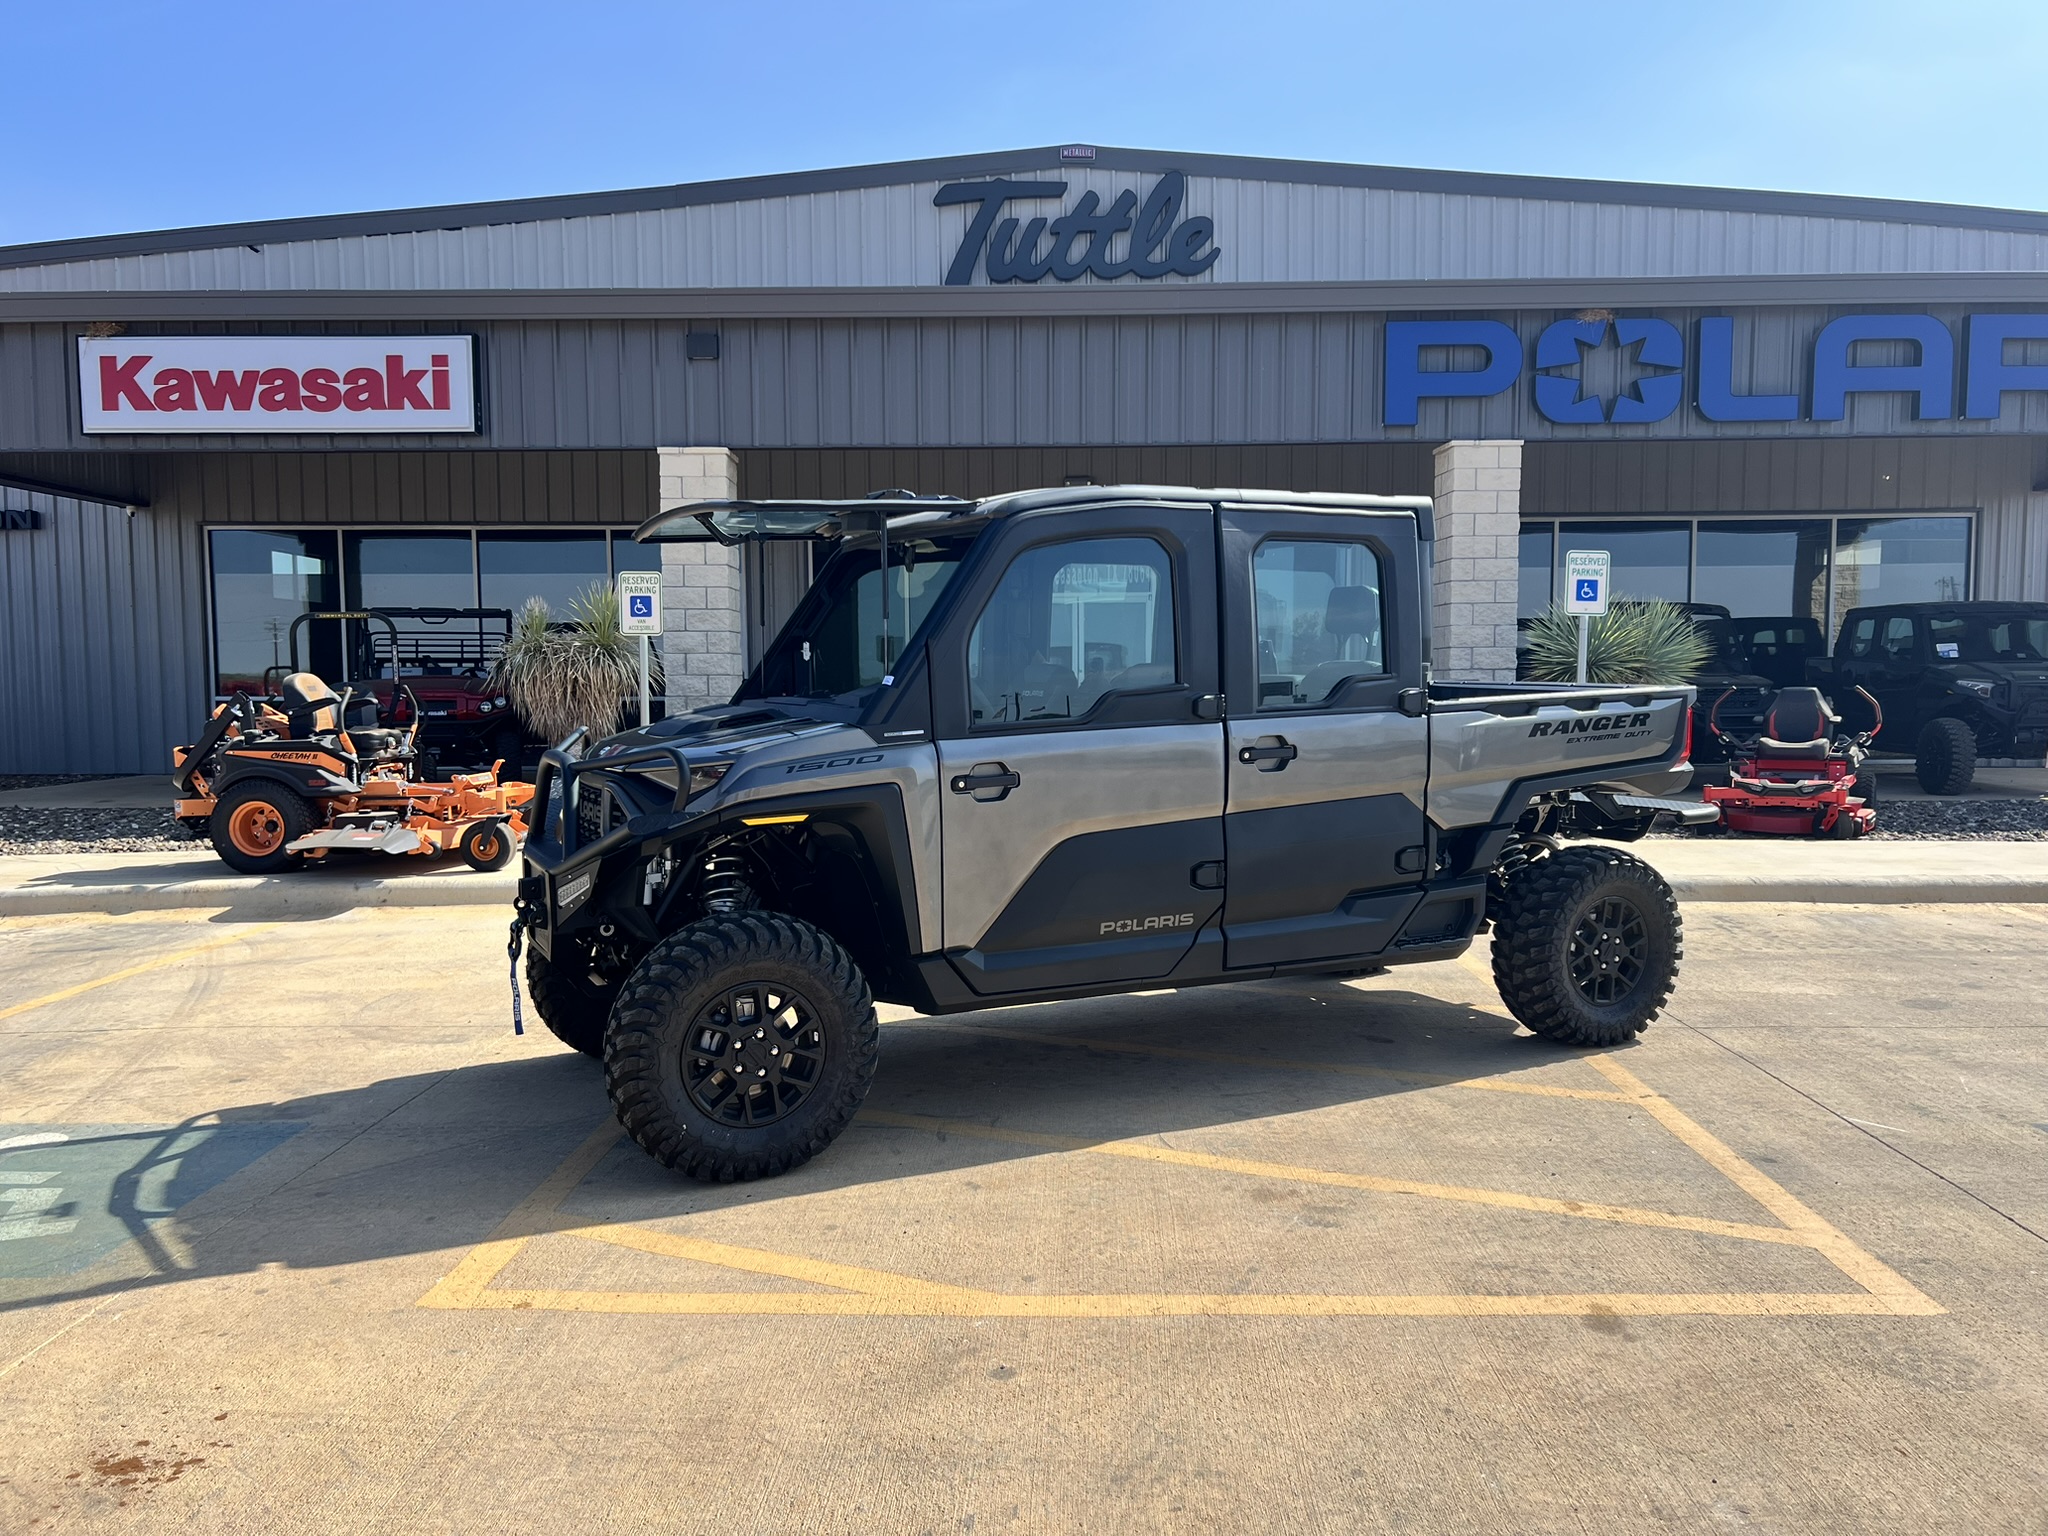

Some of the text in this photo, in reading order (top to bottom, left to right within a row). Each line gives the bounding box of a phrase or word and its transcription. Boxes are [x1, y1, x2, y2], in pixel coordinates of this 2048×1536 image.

[933, 170, 1222, 285] Tuttle
[99, 353, 451, 413] Kawasaki
[1570, 557, 1607, 566] RESERVED
[622, 576, 659, 585] RESERVED
[1571, 568, 1604, 577] PARKING
[624, 586, 657, 594] PARKING
[1528, 712, 1651, 738] RANGER
[1566, 729, 1655, 744] EXTREME DUTY
[270, 752, 311, 760] CHEETAH
[785, 754, 885, 775] 1500
[579, 798, 601, 824] LARIS
[1099, 913, 1195, 935] POLARIS
[511, 977, 522, 1021] POLARIS
